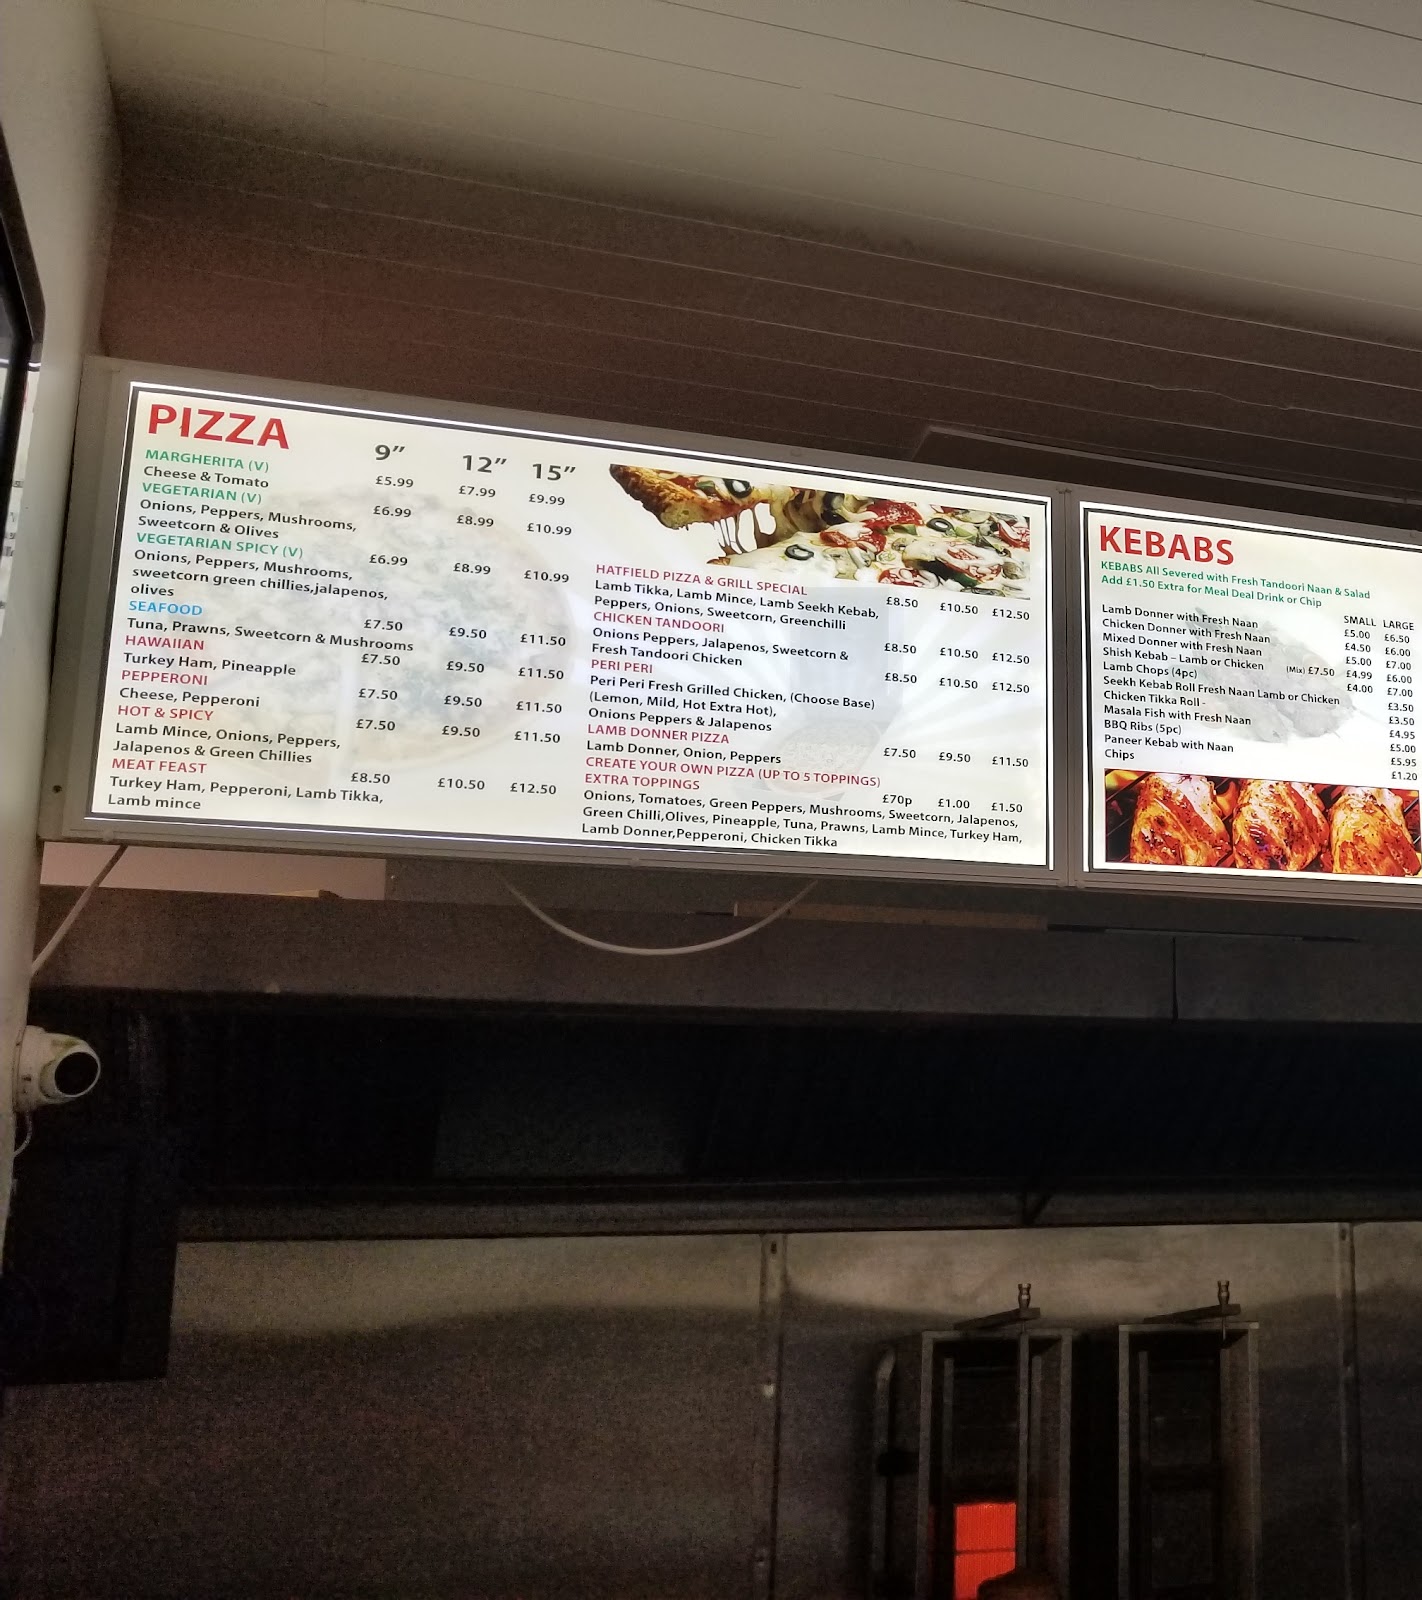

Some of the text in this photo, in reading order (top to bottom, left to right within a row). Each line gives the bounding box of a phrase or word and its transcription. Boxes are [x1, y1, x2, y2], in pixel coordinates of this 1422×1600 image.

[148, 403, 289, 449] PIZZA
[143, 465, 268, 488] Cheese & Tomato
[145, 449, 565, 505] MARGHERITA (V) £5.99 £7.99 £9.99
[142, 482, 571, 535] VEGETARIAN (V) £6.99 £8.99 £10.99
[137, 515, 278, 538] Sweetcorn & Olives
[136, 532, 302, 559] VEGETARIAN SPICY (V)
[1099, 524, 1233, 565] KEBABS
[596, 563, 1029, 620] HATFIELD PIZZA & GRILL SPECIAL £8.50 £10.50 £12.50
[1101, 560, 1370, 598] KEBABS All Severed with Fresh Tandoori Naan & Salad
[128, 600, 566, 646] SEAFOOD £7.50 £9.50 £11.50
[593, 611, 723, 632] CHICKEN TANDOORI
[1343, 615, 1414, 630] SMALL LARGE
[125, 634, 204, 650] HAWAIIAN
[121, 669, 207, 685] PEPPERONI
[123, 652, 296, 676] Turkey Ham, Pineapple
[591, 658, 652, 673] PERI PERI
[1103, 660, 1413, 697] Lamb Chops (4pc) £4.00 £7.00
[1286, 665, 1334, 676] (Mix) £7.50
[117, 704, 213, 720] HOT & SPICY
[119, 687, 259, 707] Cheese, Pepperoni
[587, 723, 1028, 767] LAMB DONNER PIZZA £7.50 £9.50 £11.50
[1104, 733, 1416, 767] Paneer Kebab with Naan £5.95
[111, 758, 556, 794] MEAT FEAST £8.50 £10.50 £12.50
[1104, 748, 1417, 780] Chips £1.20
[585, 773, 1022, 813] EXTRA TOPPINGS £70p £1.00 £1.50
